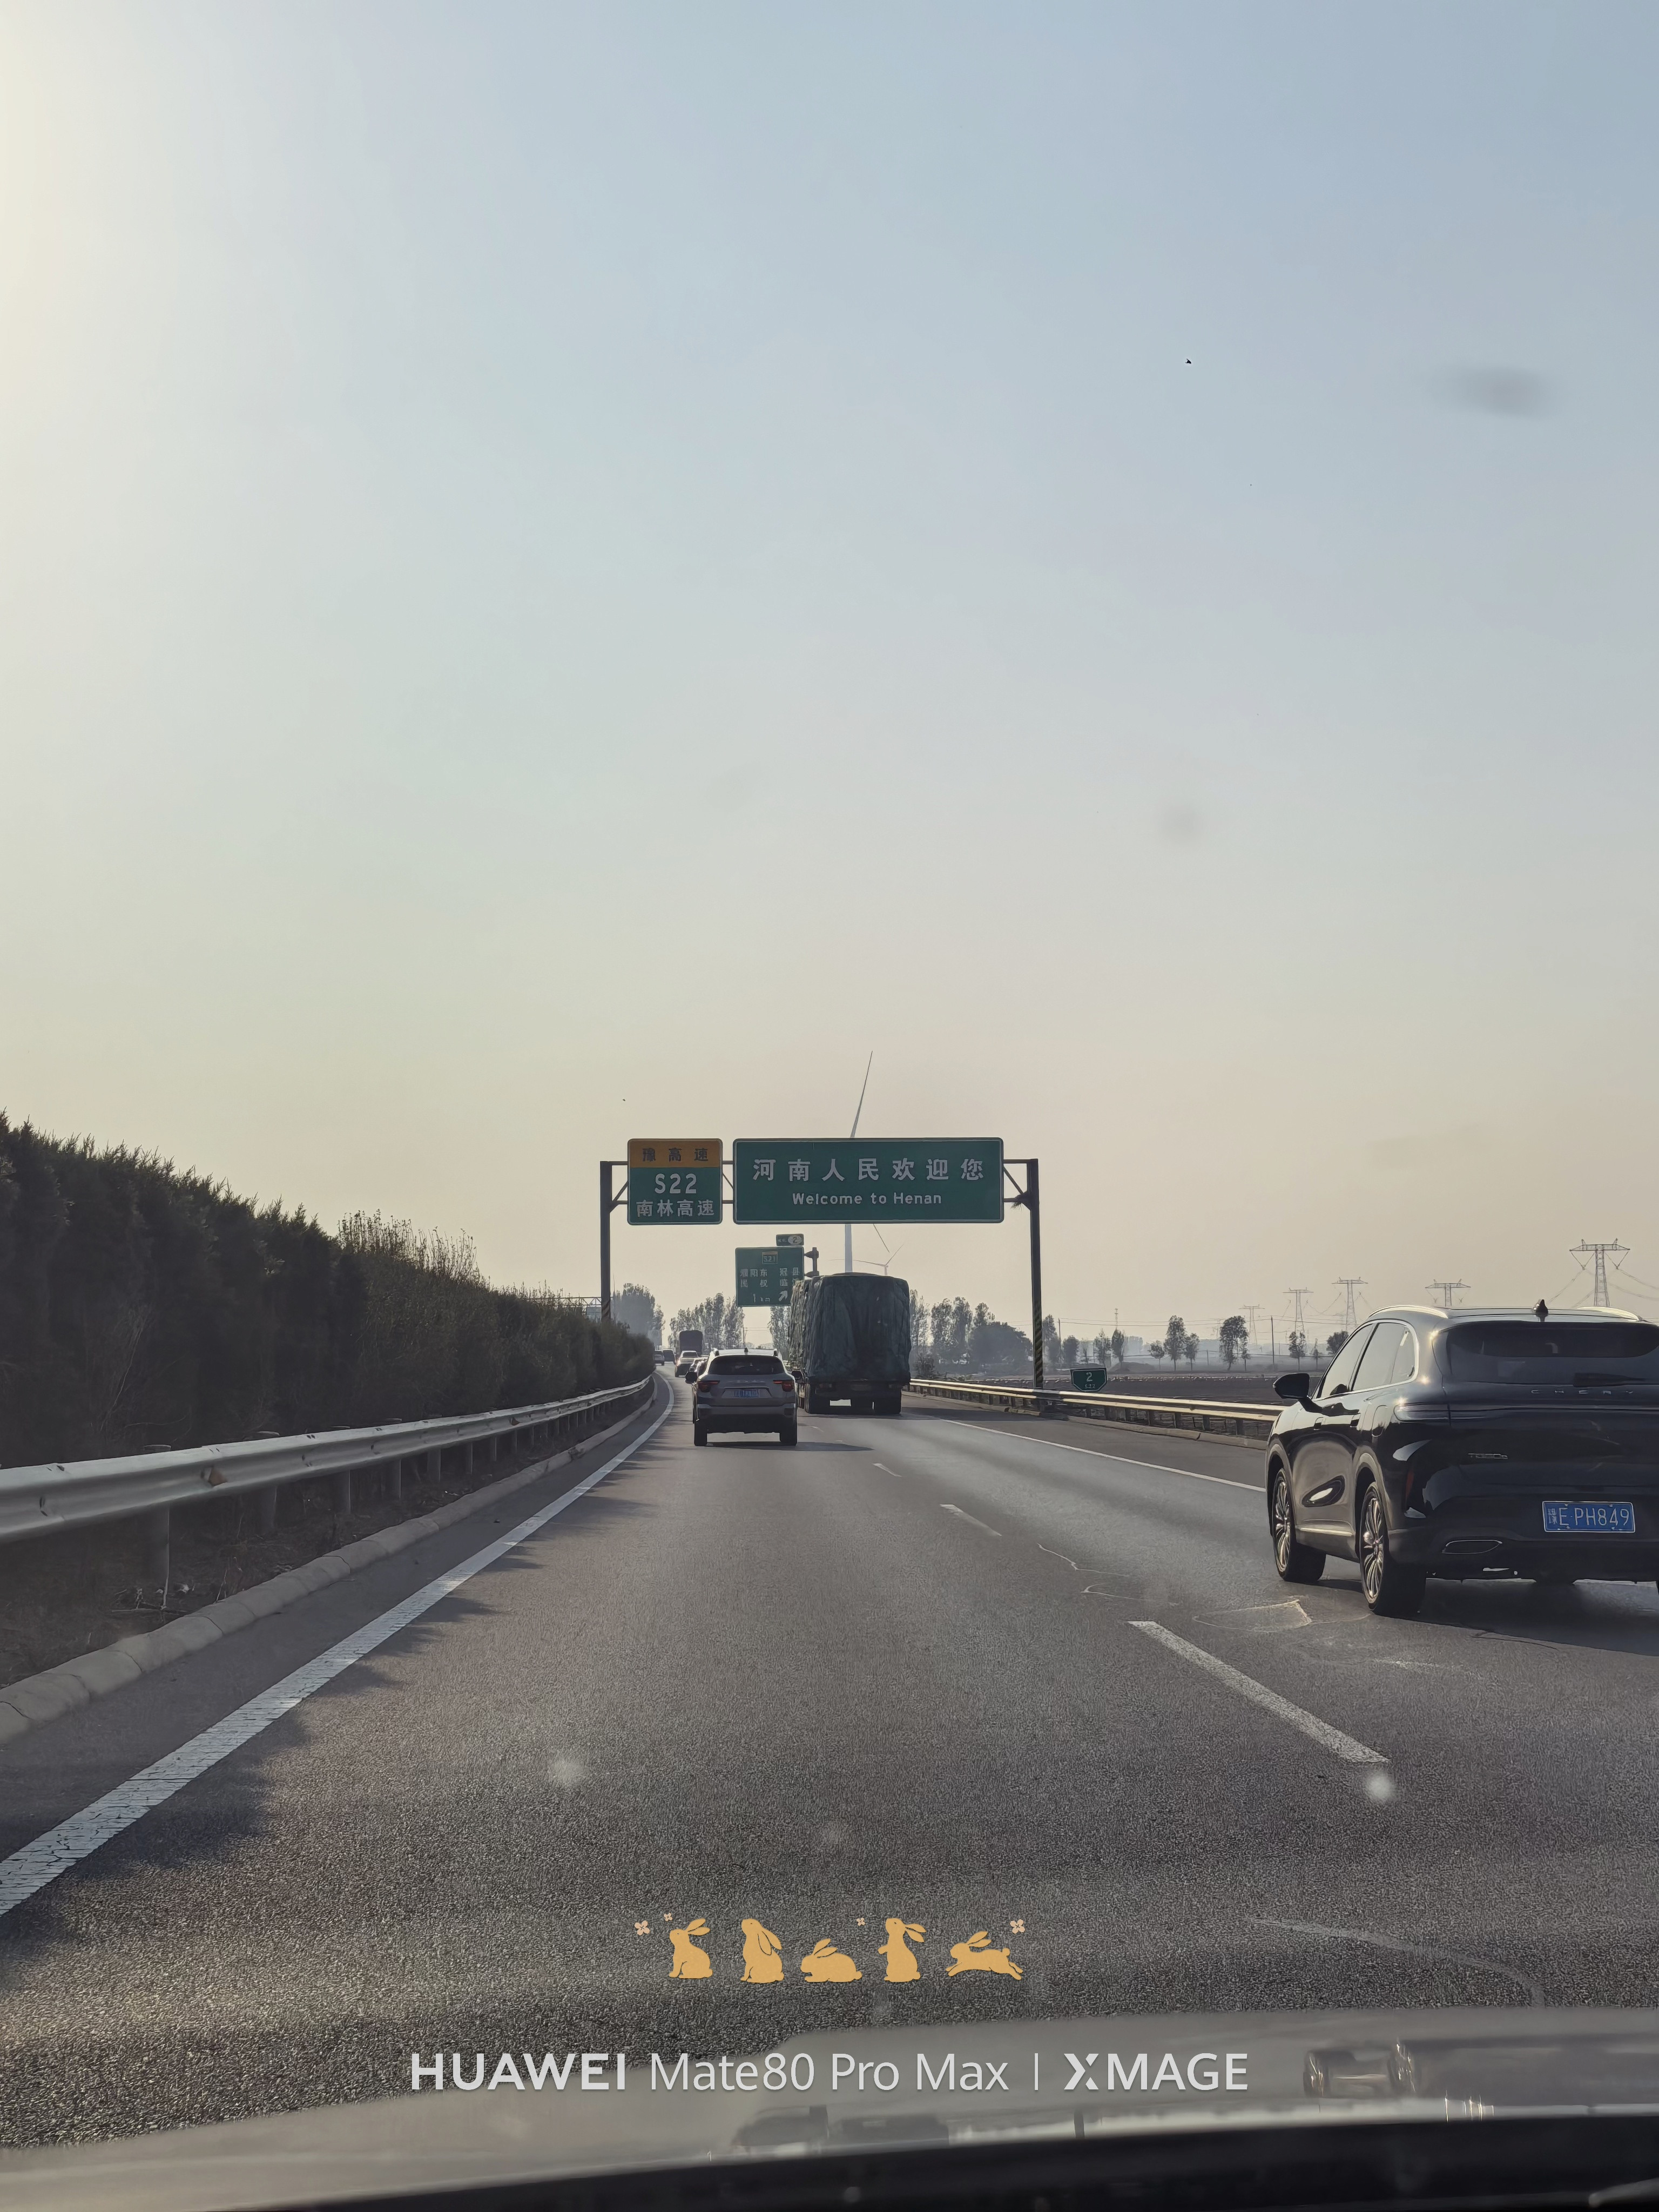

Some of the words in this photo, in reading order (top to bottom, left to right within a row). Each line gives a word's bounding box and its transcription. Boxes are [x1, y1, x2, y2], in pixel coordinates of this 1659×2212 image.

[642, 1147, 709, 1162] 豫高速
[752, 1157, 984, 1182] 河南人民欢迎您
[654, 1173, 697, 1194] S22
[792, 1192, 862, 1205] Welcome
[871, 1192, 888, 1205] to
[893, 1192, 942, 1205] Henan
[636, 1199, 714, 1217] 南林高速
[1086, 1372, 1093, 1382] 2
